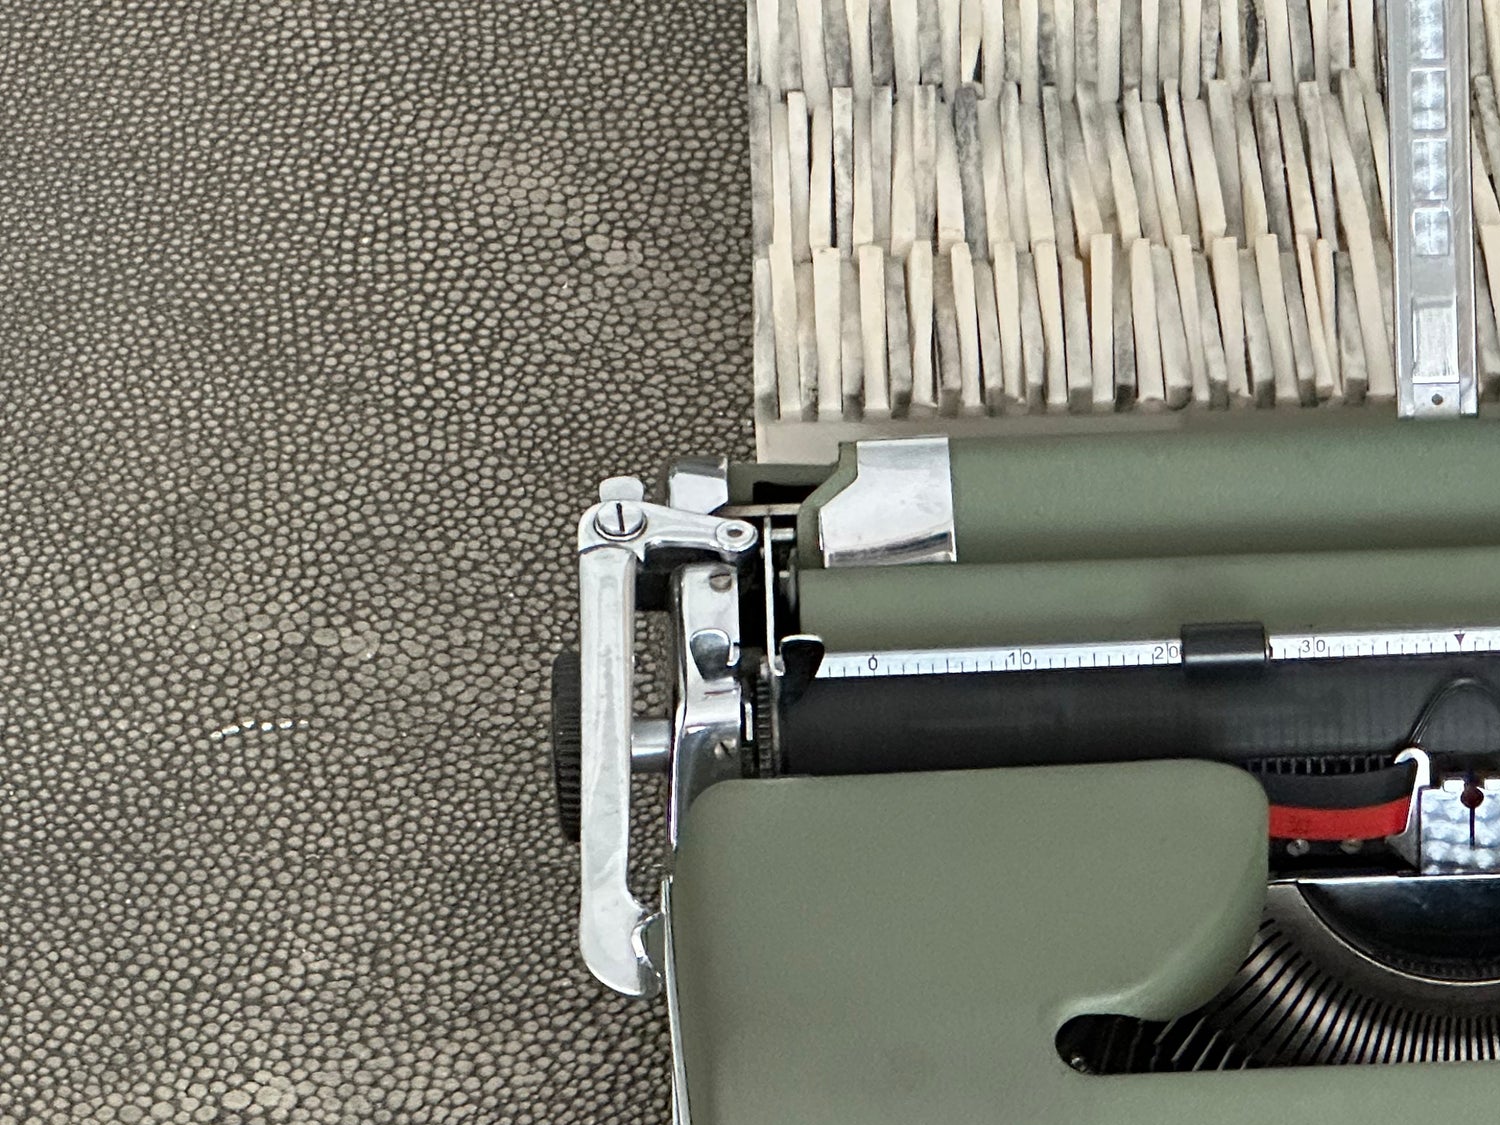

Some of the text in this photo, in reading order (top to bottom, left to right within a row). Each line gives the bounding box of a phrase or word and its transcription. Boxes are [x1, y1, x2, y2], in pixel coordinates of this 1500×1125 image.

[868, 656, 878, 671] 0
[1008, 651, 1032, 666] 10
[1154, 645, 1178, 660] 20
[1302, 639, 1326, 653] 30
